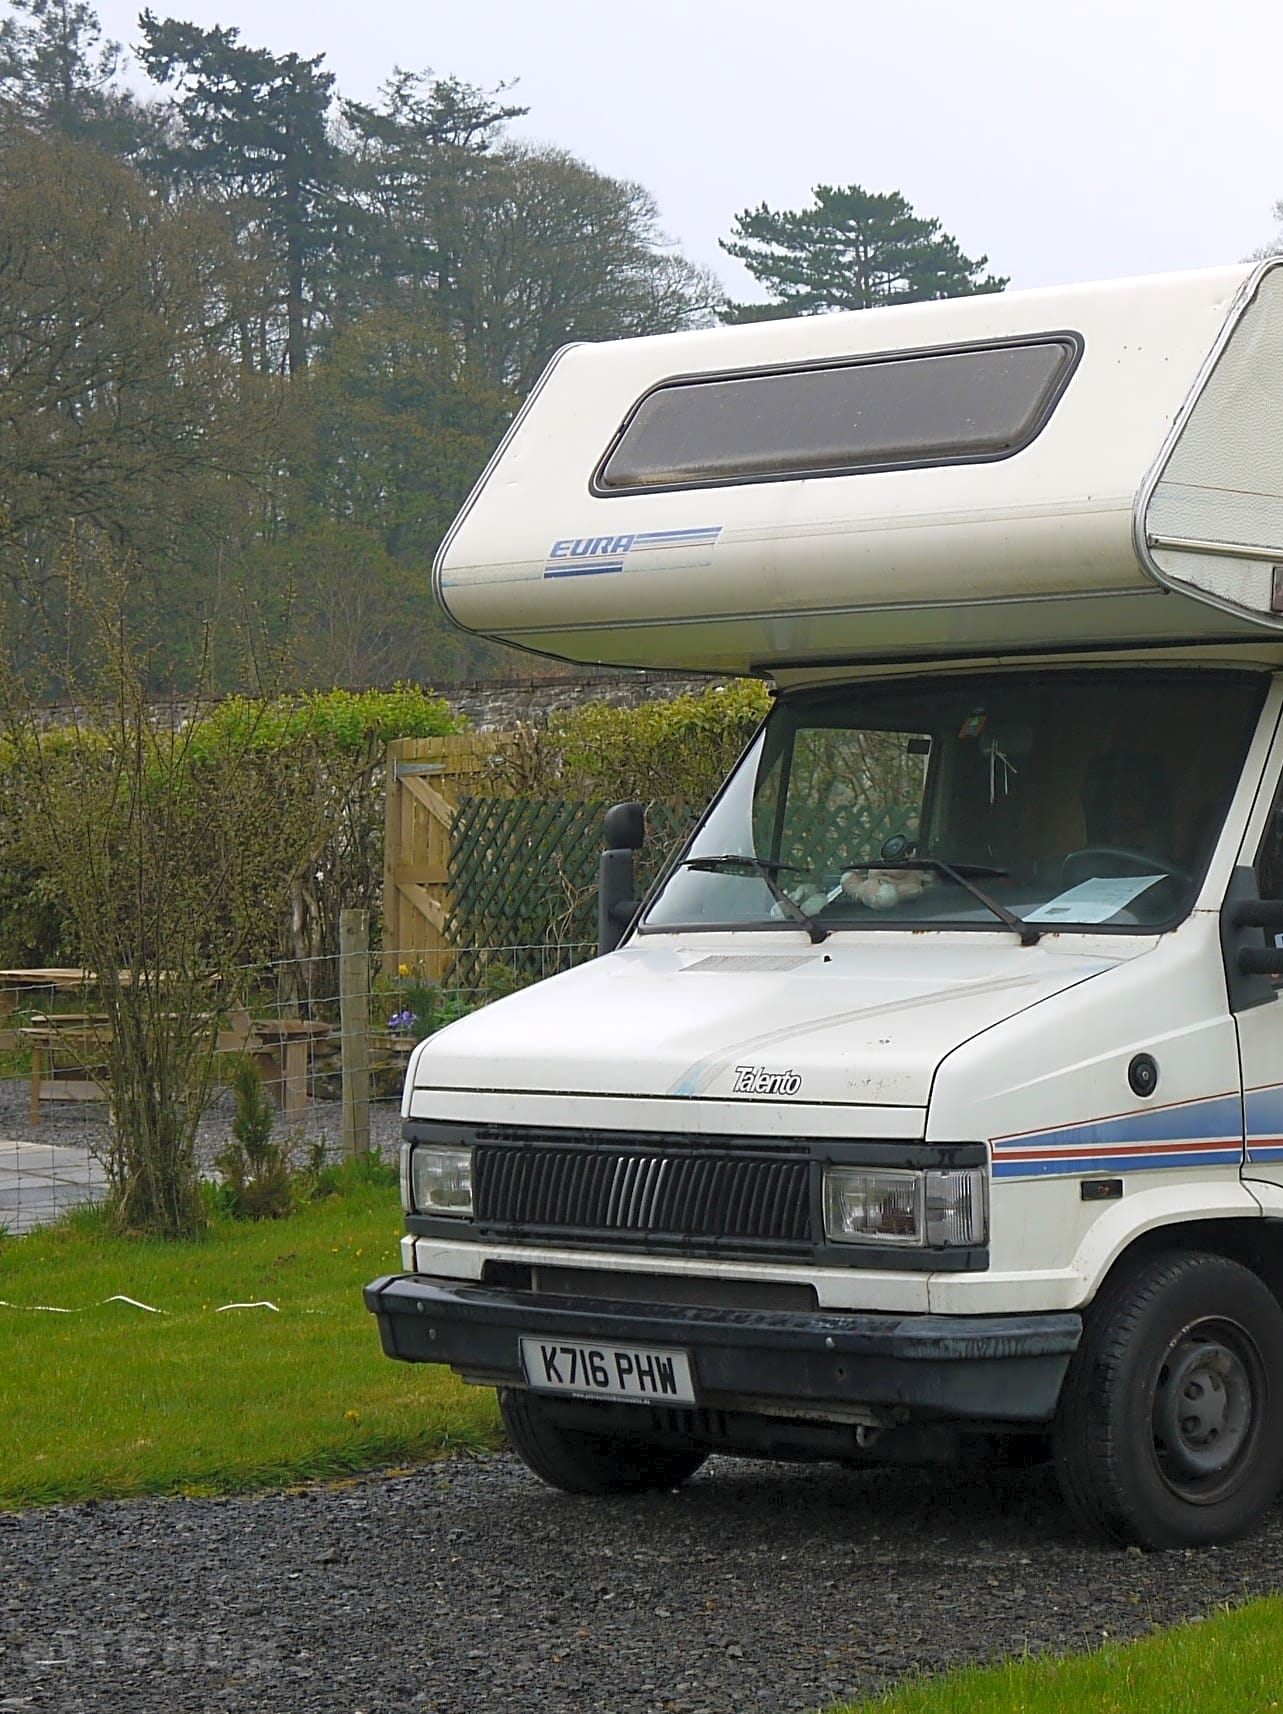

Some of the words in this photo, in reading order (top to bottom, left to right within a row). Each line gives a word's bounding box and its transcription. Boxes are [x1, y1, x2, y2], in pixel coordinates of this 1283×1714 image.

[550, 535, 635, 558] EURA
[734, 1066, 802, 1095] Talento
[541, 1345, 609, 1387] K716
[614, 1352, 677, 1395] PHW
